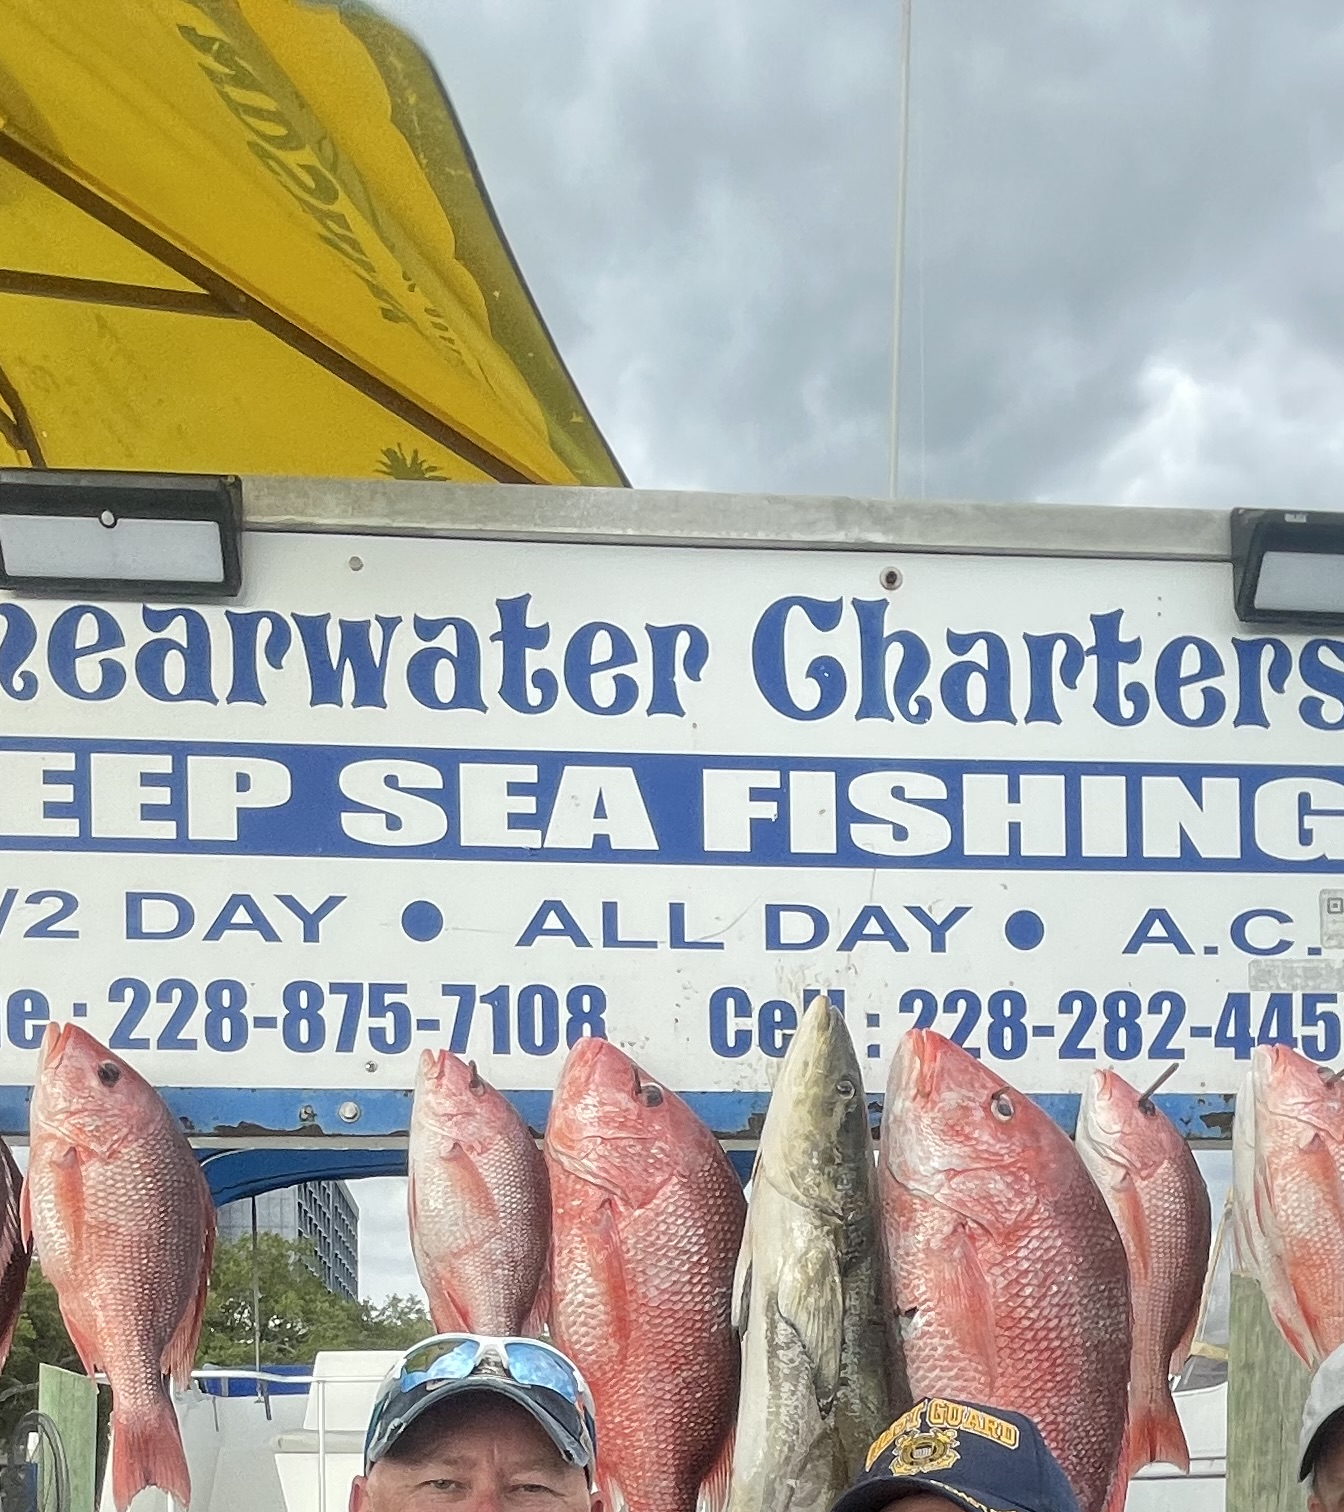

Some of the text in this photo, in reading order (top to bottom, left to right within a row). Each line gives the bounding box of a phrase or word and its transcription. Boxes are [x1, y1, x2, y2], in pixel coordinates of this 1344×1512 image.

[338, 758, 660, 852] SEA
[123, 891, 348, 945] DAY
[515, 899, 725, 951] ALL
[764, 903, 973, 954] DAY
[1121, 907, 1323, 957] A.C.
[107, 976, 607, 1056] 228-875-7108
[926, 1398, 1019, 1450] GUARD
